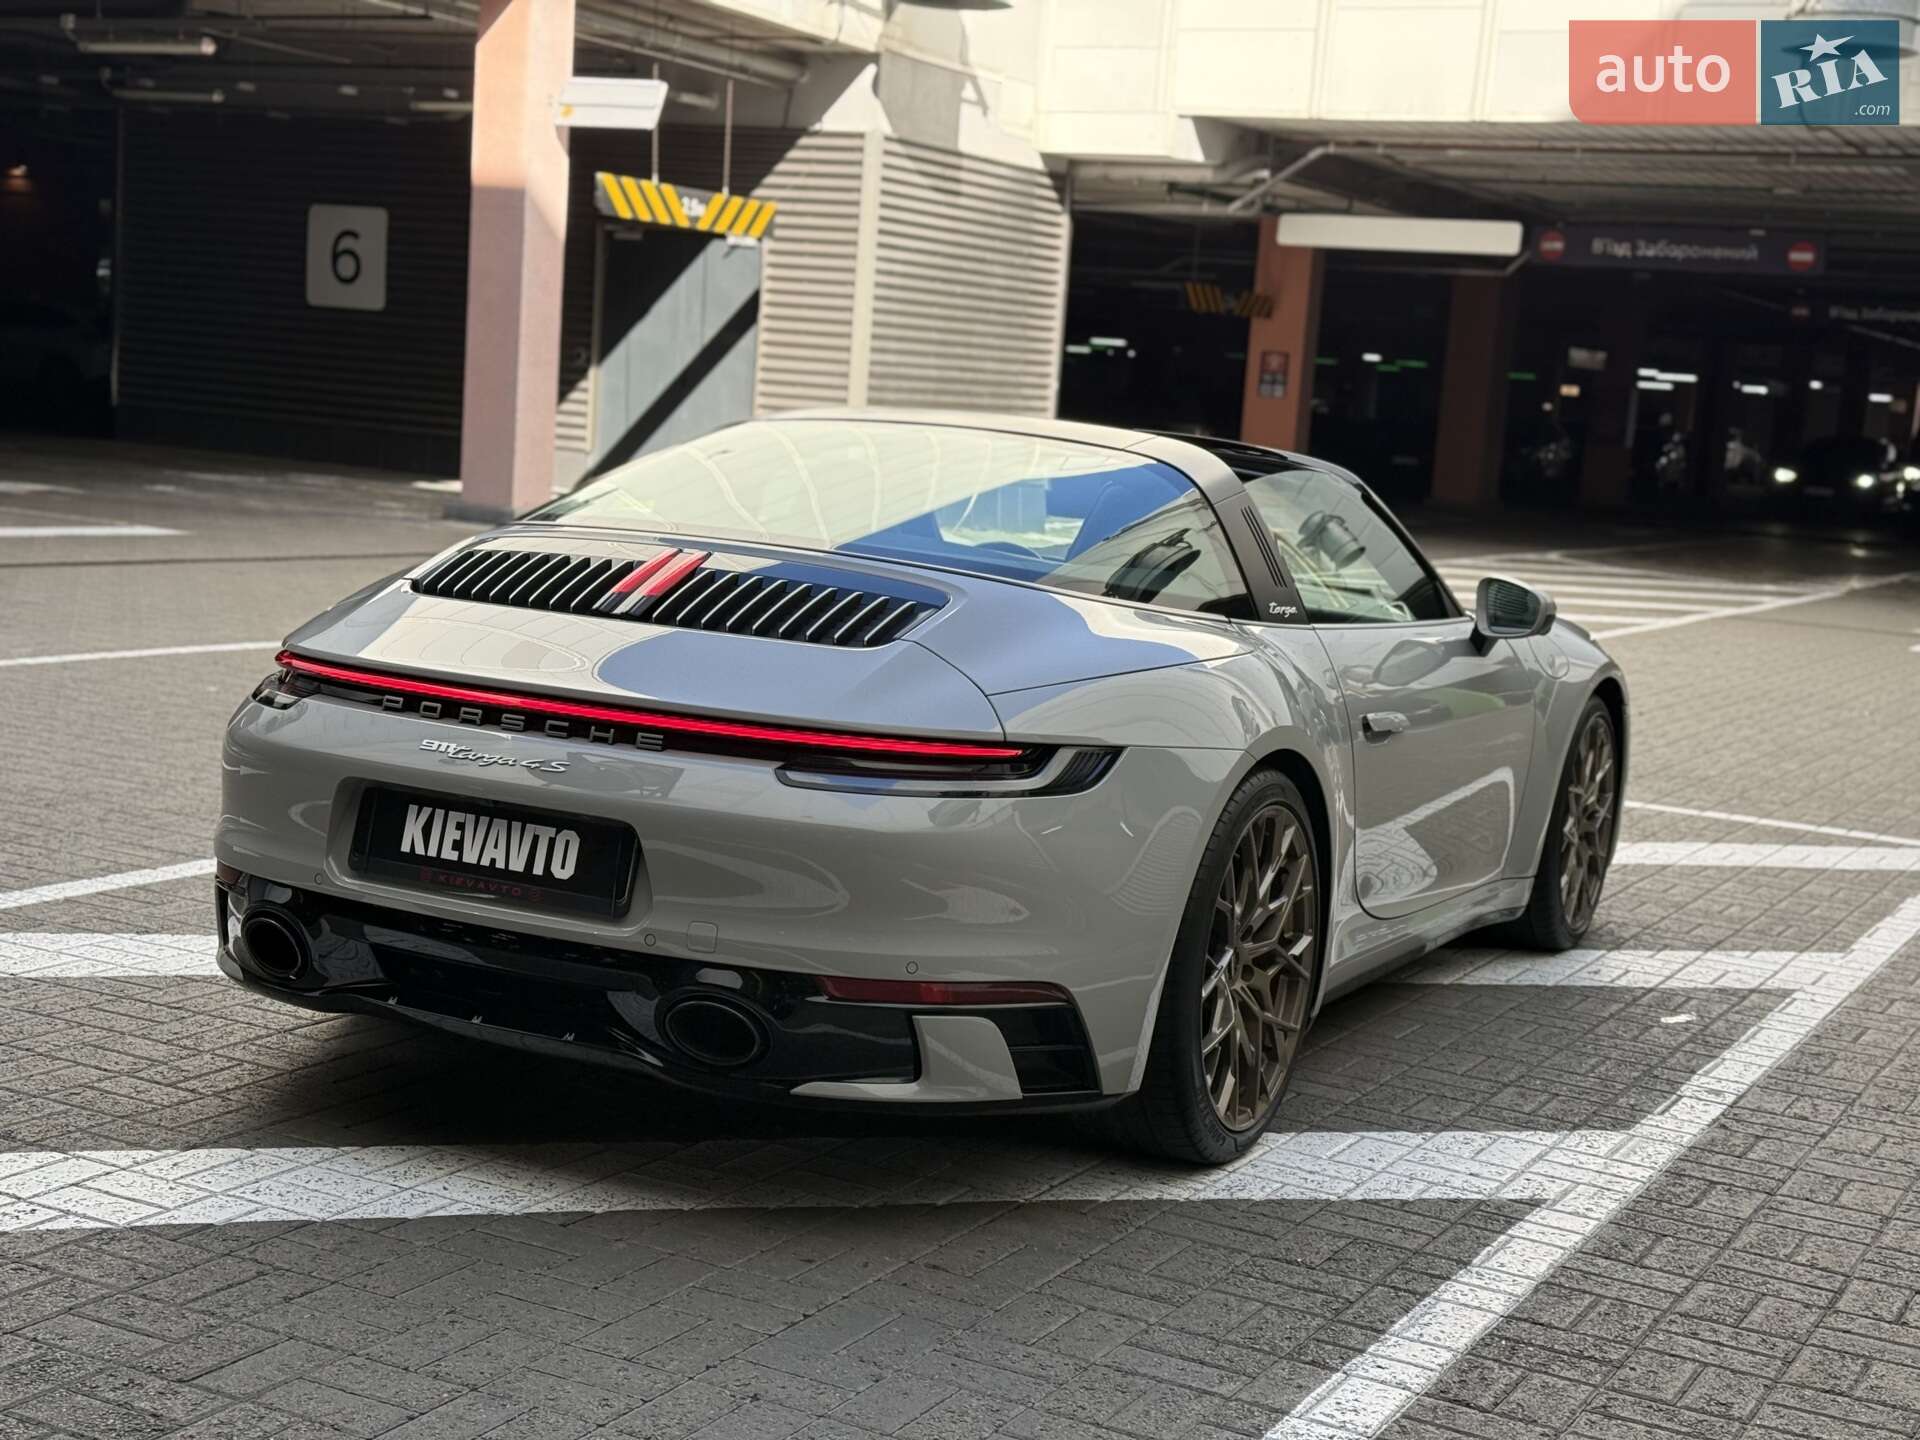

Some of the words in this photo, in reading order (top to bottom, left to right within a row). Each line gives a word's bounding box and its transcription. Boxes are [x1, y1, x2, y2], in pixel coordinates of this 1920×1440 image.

[332, 230, 361, 285] 6
[382, 694, 665, 751] PORSCHE
[400, 803, 581, 881] KIEVAVTO
